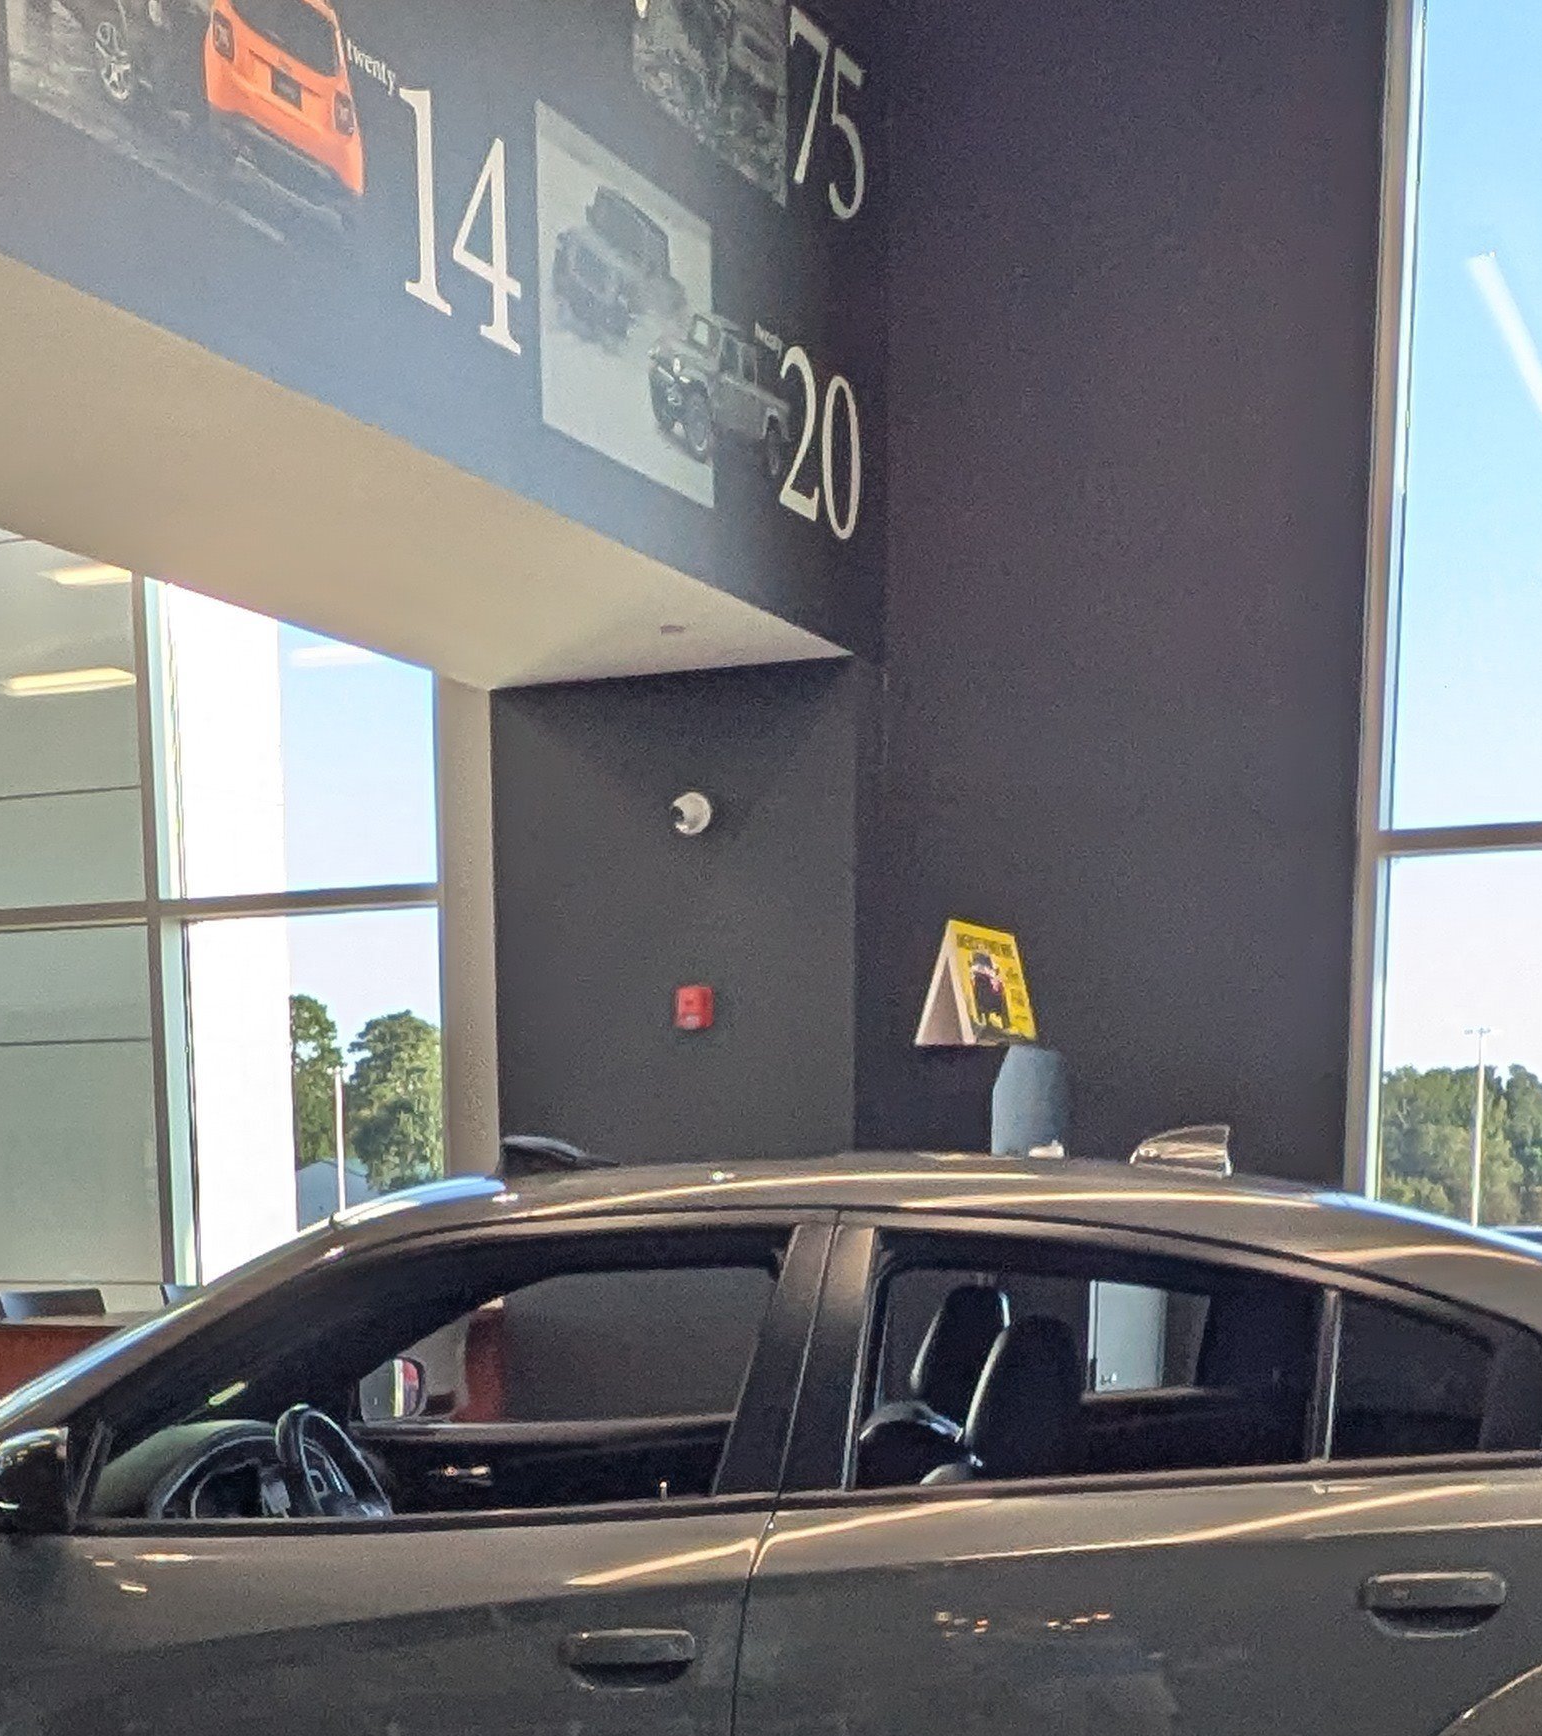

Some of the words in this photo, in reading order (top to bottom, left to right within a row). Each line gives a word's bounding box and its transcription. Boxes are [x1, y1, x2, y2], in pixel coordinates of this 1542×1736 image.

[346, 38, 397, 96] twenty
[790, 6, 867, 219] 75
[399, 87, 522, 356] 14
[779, 346, 860, 540] 20
